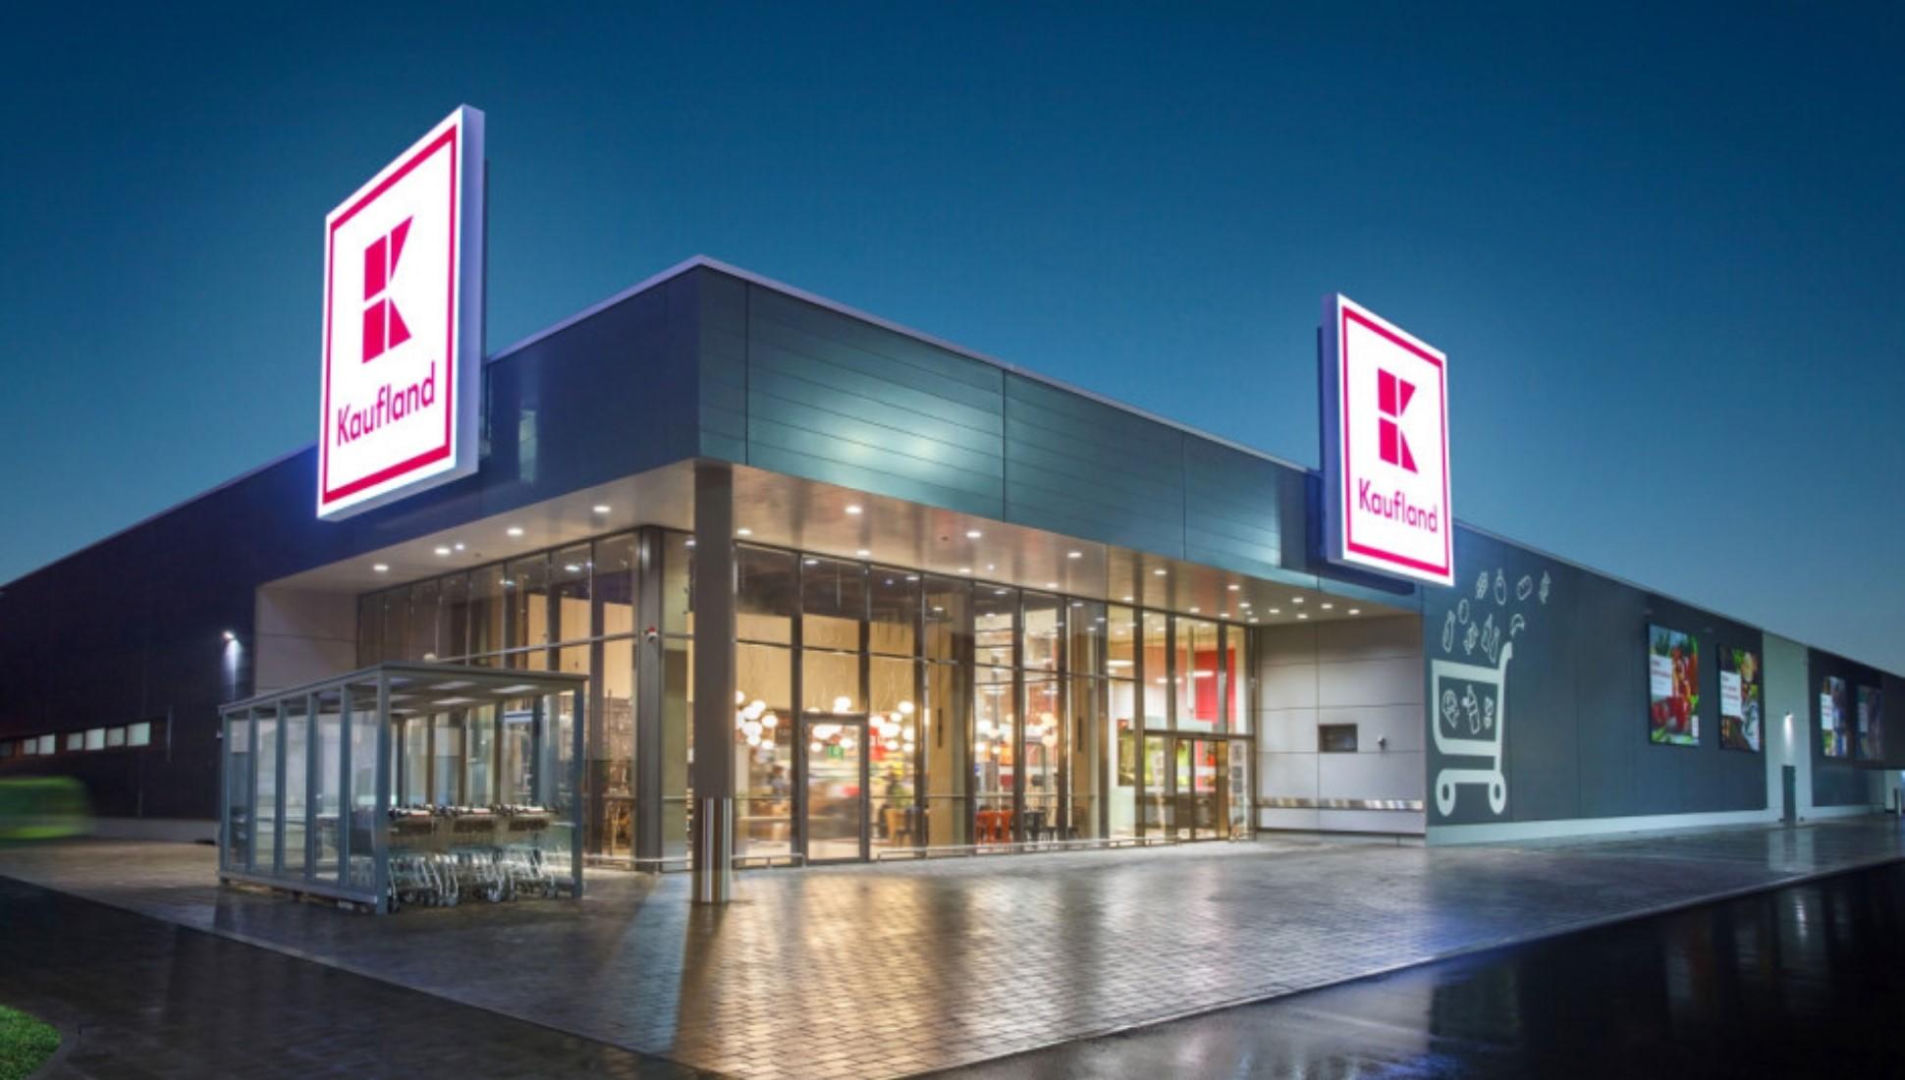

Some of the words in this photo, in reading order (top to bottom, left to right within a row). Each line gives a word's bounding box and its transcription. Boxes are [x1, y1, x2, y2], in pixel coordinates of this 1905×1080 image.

[362, 215, 414, 364] K
[337, 361, 435, 447] Kaufland
[1377, 368, 1419, 473] K
[1358, 478, 1438, 533] Kaufland
